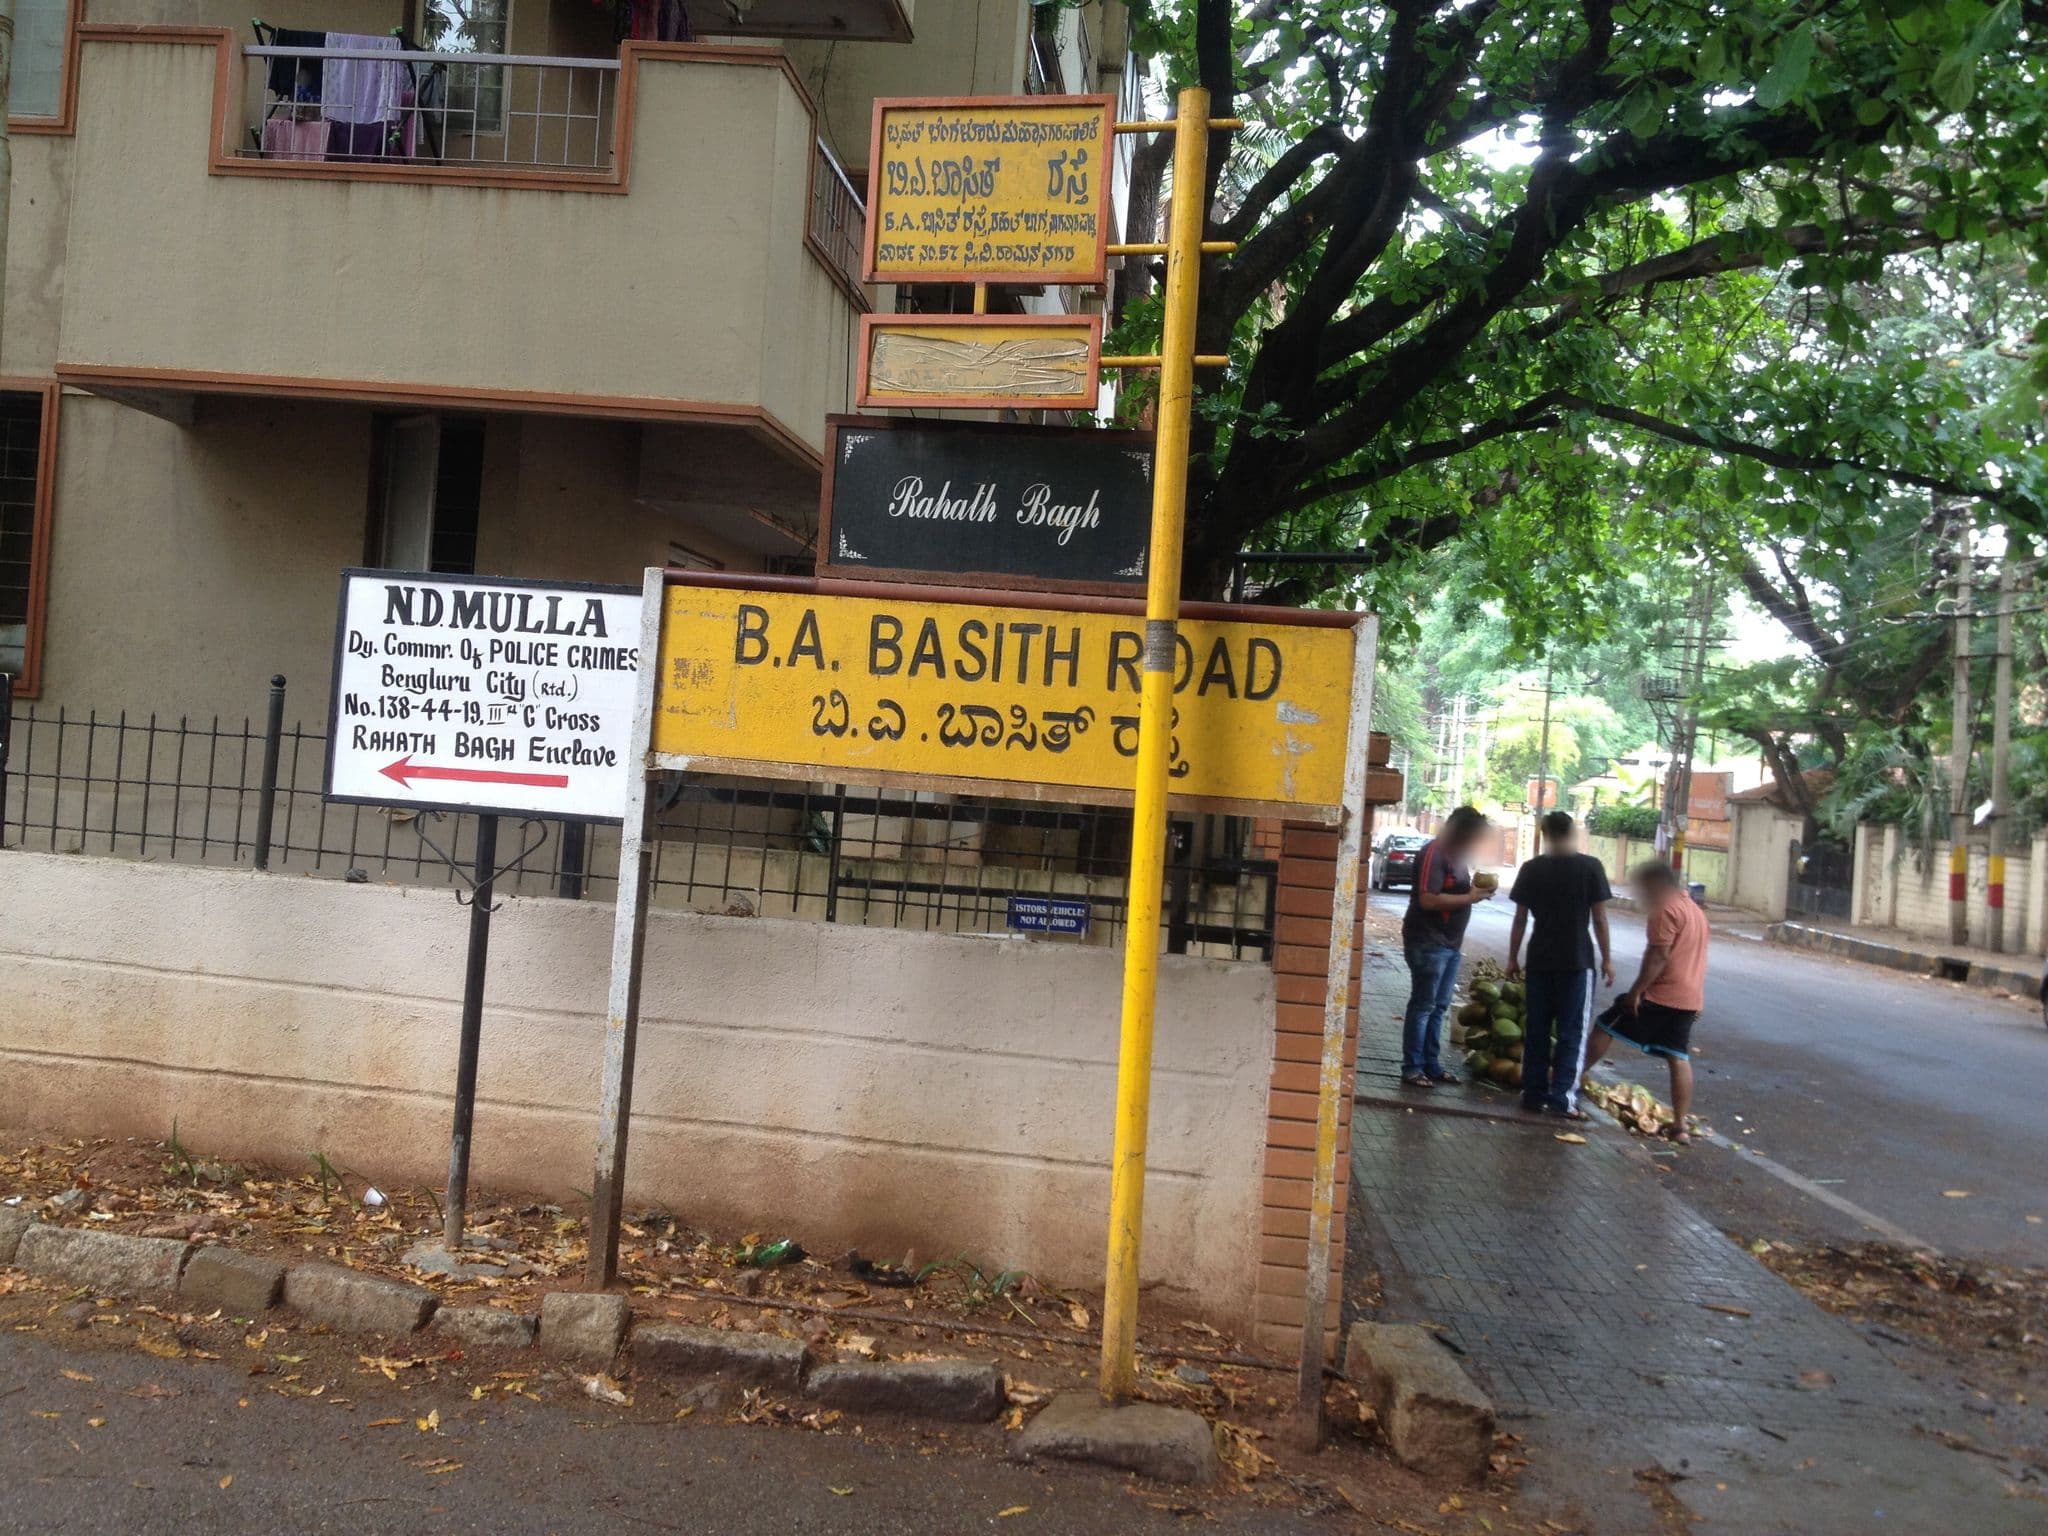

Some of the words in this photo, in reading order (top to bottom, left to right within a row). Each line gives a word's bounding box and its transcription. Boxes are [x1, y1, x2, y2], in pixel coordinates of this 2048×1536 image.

[1047, 147, 1089, 206] ರಸ್ತೆ
[888, 474, 998, 523] Rahath
[1016, 482, 1100, 546] Bagh
[348, 631, 379, 659] Dy.
[384, 632, 454, 660] Commr.
[460, 638, 484, 671] Of
[489, 639, 559, 667] POLICE
[567, 646, 639, 672] CRIMES
[735, 603, 840, 673] B.A.
[868, 614, 1082, 688] BASITH
[1107, 630, 1284, 701] ROAD
[381, 664, 471, 695] Bengluru
[486, 671, 526, 703] City
[532, 671, 579, 703] (Rtd.)
[545, 706, 601, 733] Cross
[352, 725, 437, 756] RAHATH
[455, 731, 516, 762] BAGH
[528, 737, 618, 768] Enclave
[1014, 903, 1048, 914] ISITORS
[1019, 915, 1037, 925] NOT
